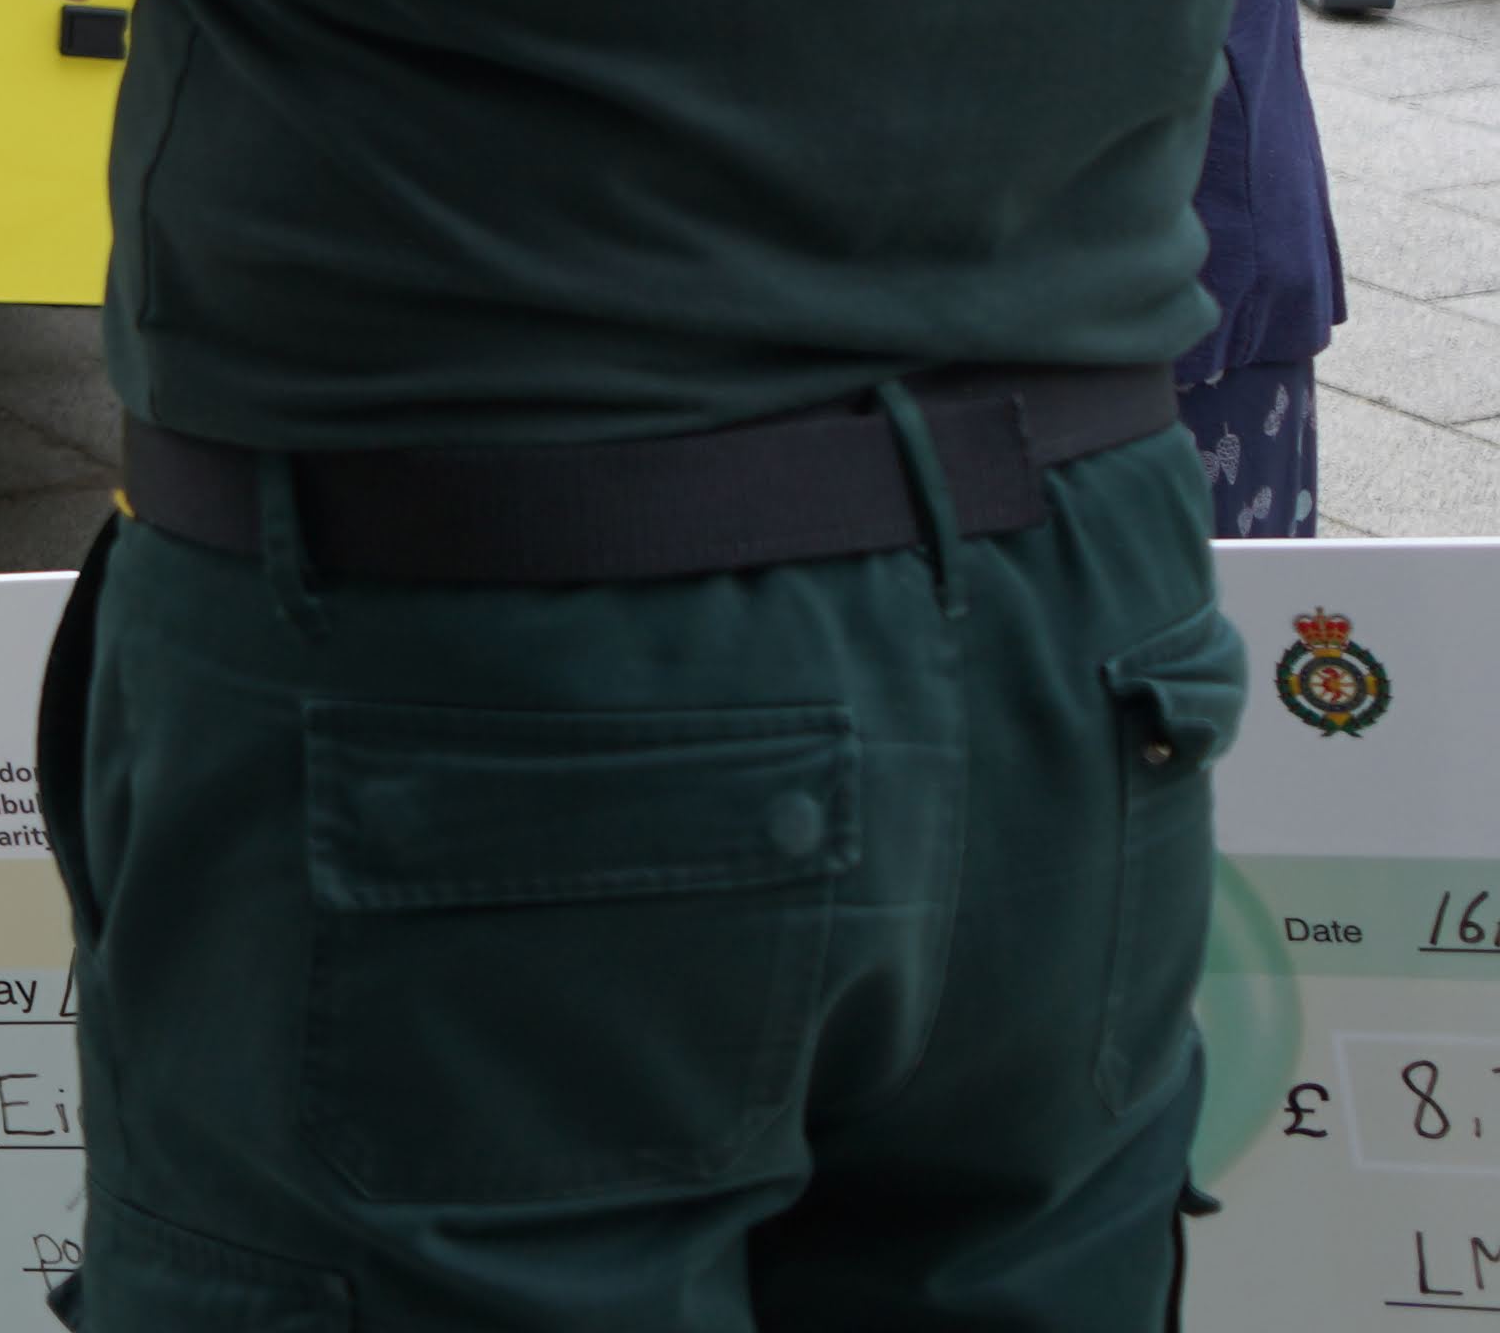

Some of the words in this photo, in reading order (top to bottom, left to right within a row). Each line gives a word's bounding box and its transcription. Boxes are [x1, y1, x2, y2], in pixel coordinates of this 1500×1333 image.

[1284, 917, 1364, 944] Date
[1429, 890, 1500, 947] 16
[1283, 1082, 1330, 1138] £
